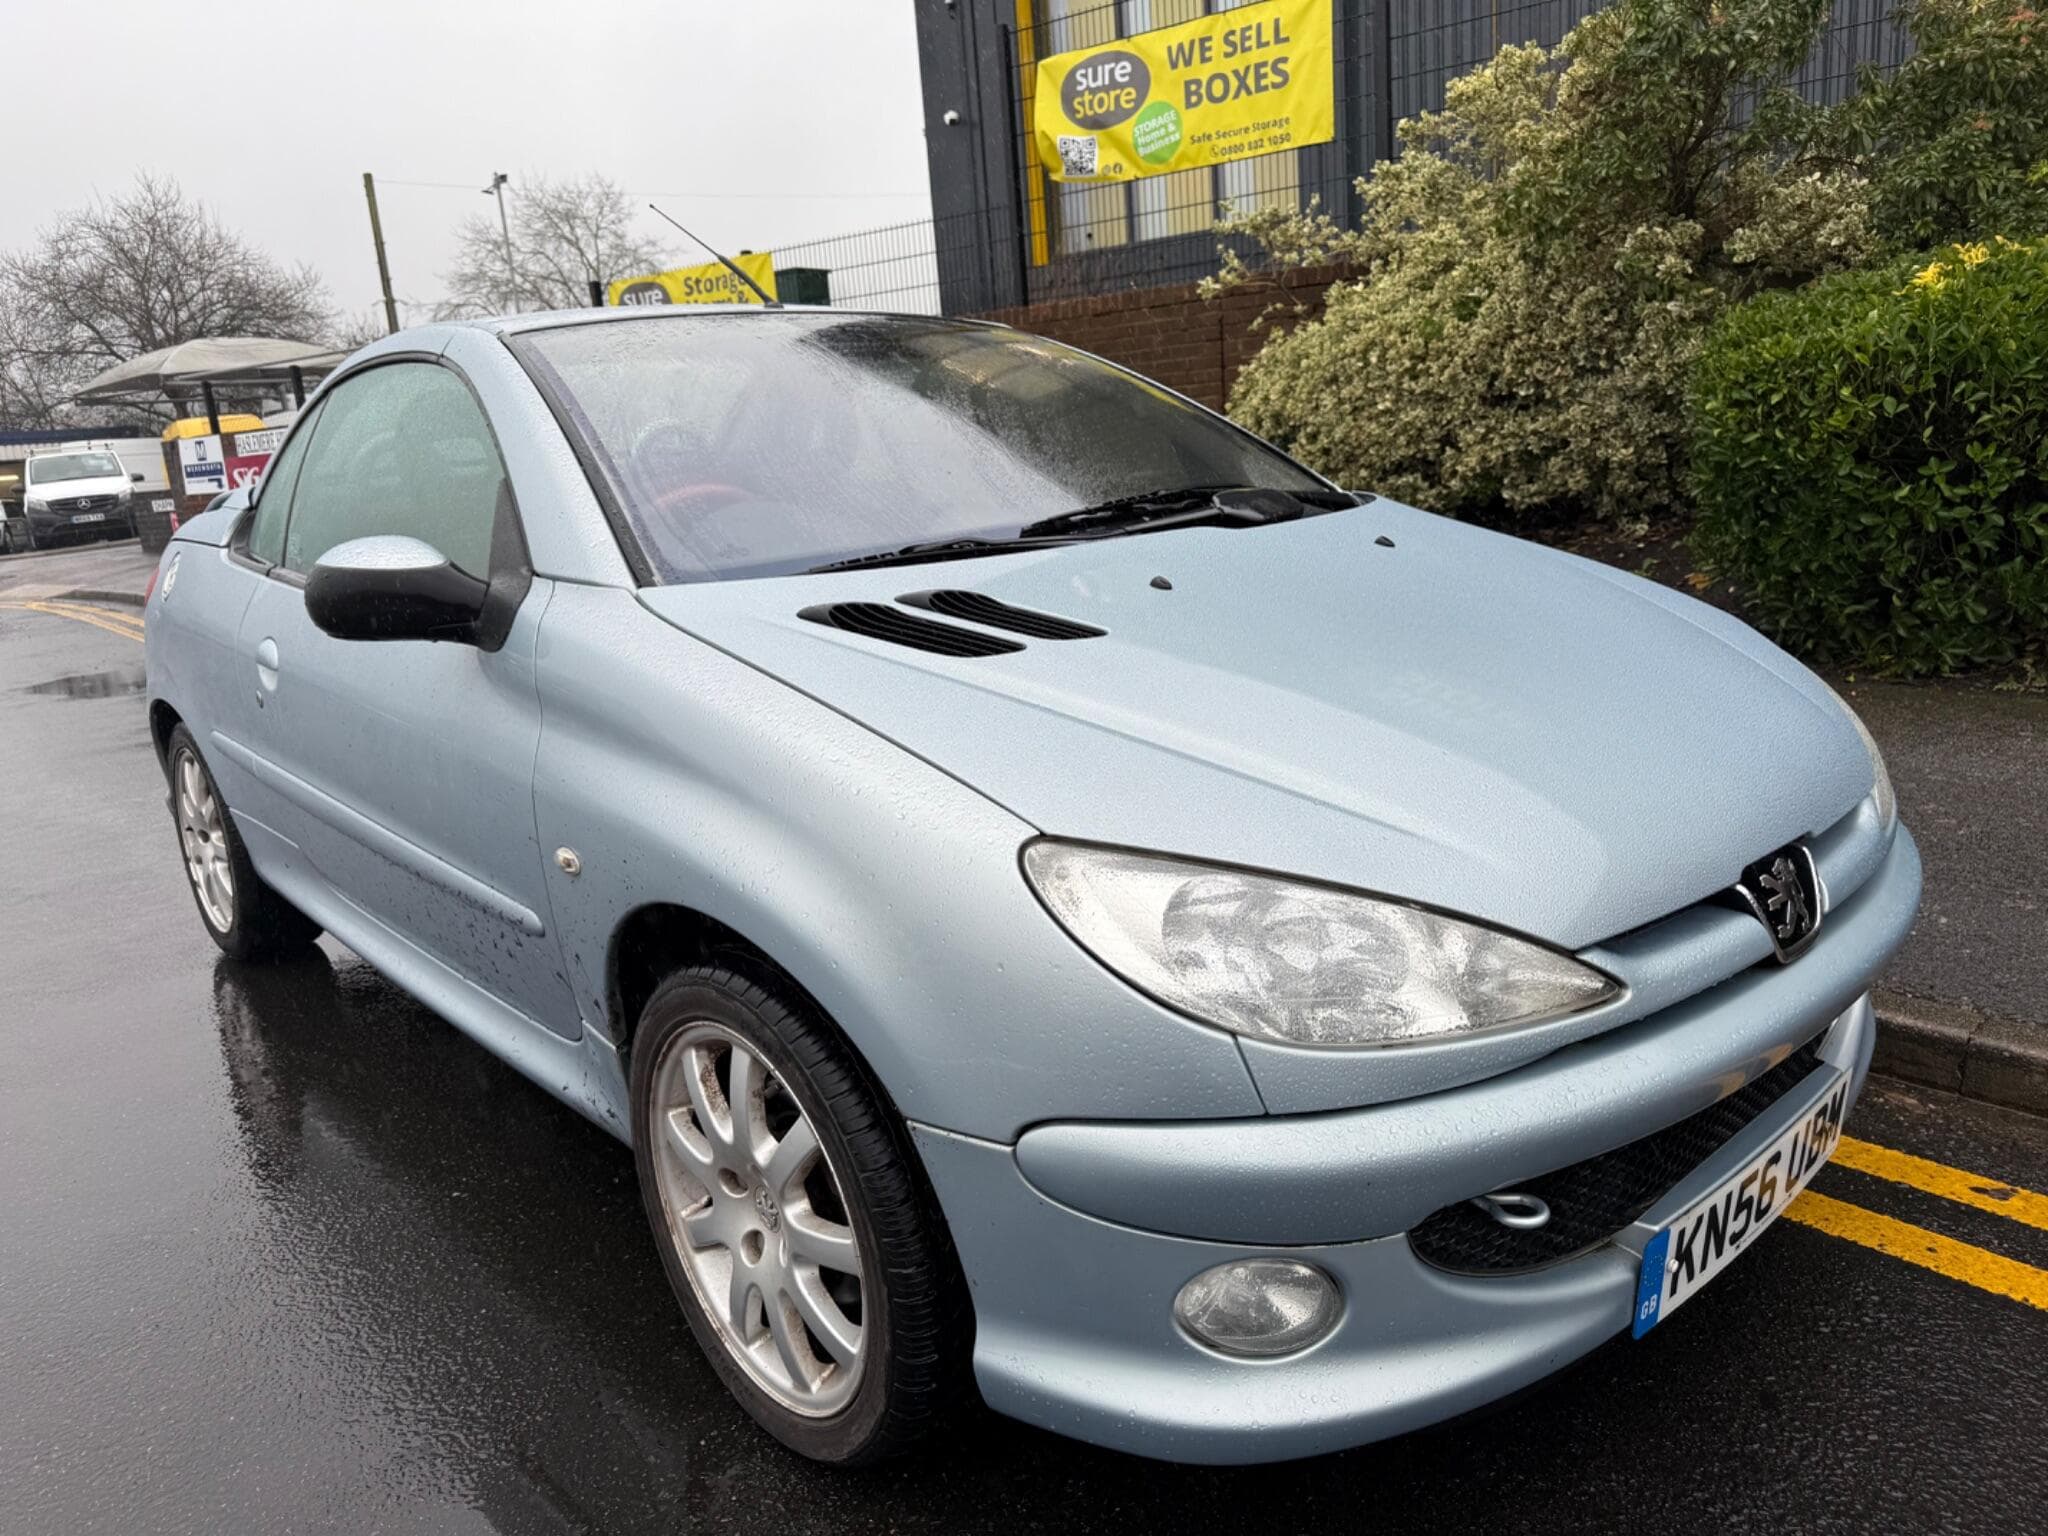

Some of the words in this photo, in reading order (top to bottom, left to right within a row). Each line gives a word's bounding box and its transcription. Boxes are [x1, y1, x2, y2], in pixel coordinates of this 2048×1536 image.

[1167, 36, 1213, 71] WE
[1222, 17, 1291, 58] SELL
[1075, 59, 1133, 91] sure
[1184, 56, 1290, 111] BOXES
[1072, 86, 1137, 119] store
[1134, 109, 1177, 137] STORAGE
[1137, 124, 1166, 146] Home
[1167, 122, 1176, 132] &
[1190, 132, 1213, 145] Safe
[1215, 126, 1250, 140] Secure
[1252, 116, 1290, 132] Storage
[1267, 132, 1292, 146] 1050
[1669, 1150, 1782, 1298] KN56
[1640, 1294, 1658, 1320] GB
